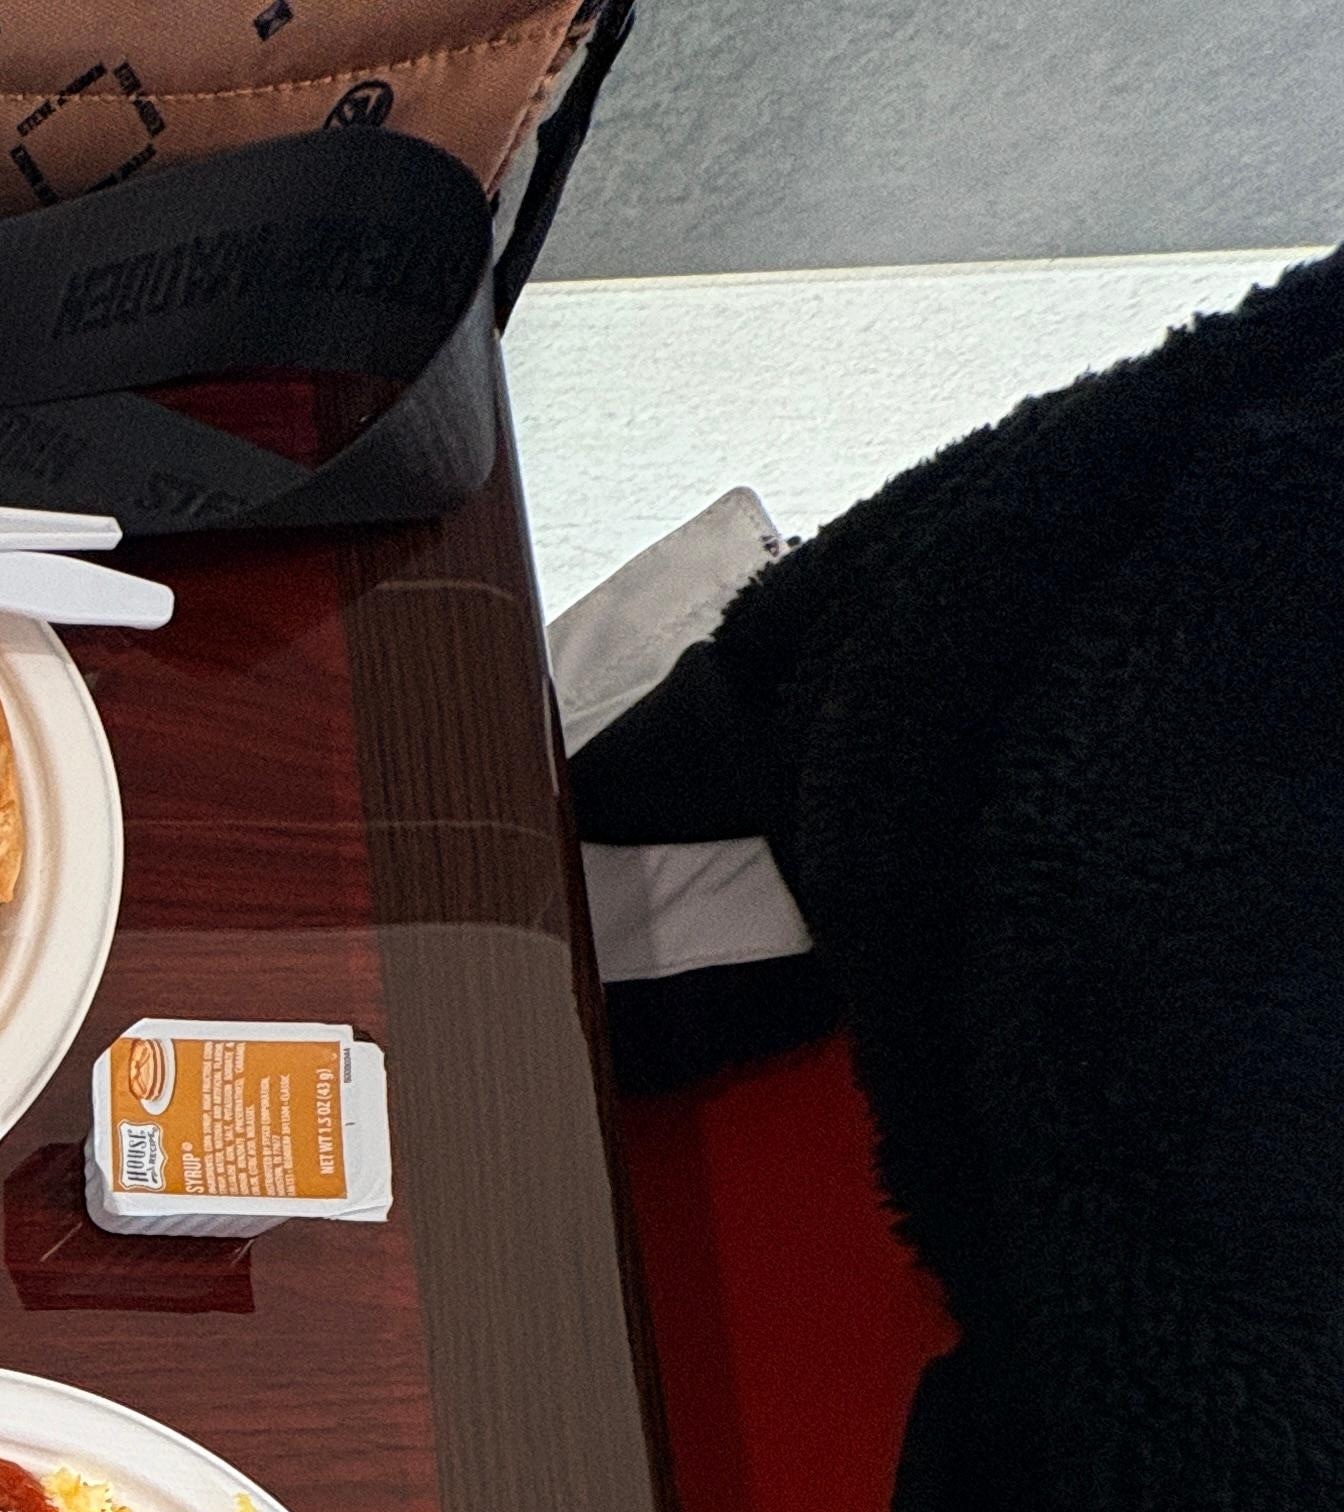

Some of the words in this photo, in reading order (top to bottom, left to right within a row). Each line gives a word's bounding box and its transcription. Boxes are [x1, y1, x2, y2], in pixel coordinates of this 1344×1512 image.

[316, 1068, 334, 1081] g)
[316, 1082, 333, 1100] (43
[316, 1100, 332, 1116] OZ
[317, 1115, 333, 1134] 1.5
[147, 1130, 158, 1165] RECIPE
[317, 1135, 334, 1153] WT
[126, 1128, 150, 1183] HOUSE
[319, 1154, 335, 1175] NET
[182, 1152, 205, 1194] SYRUP
